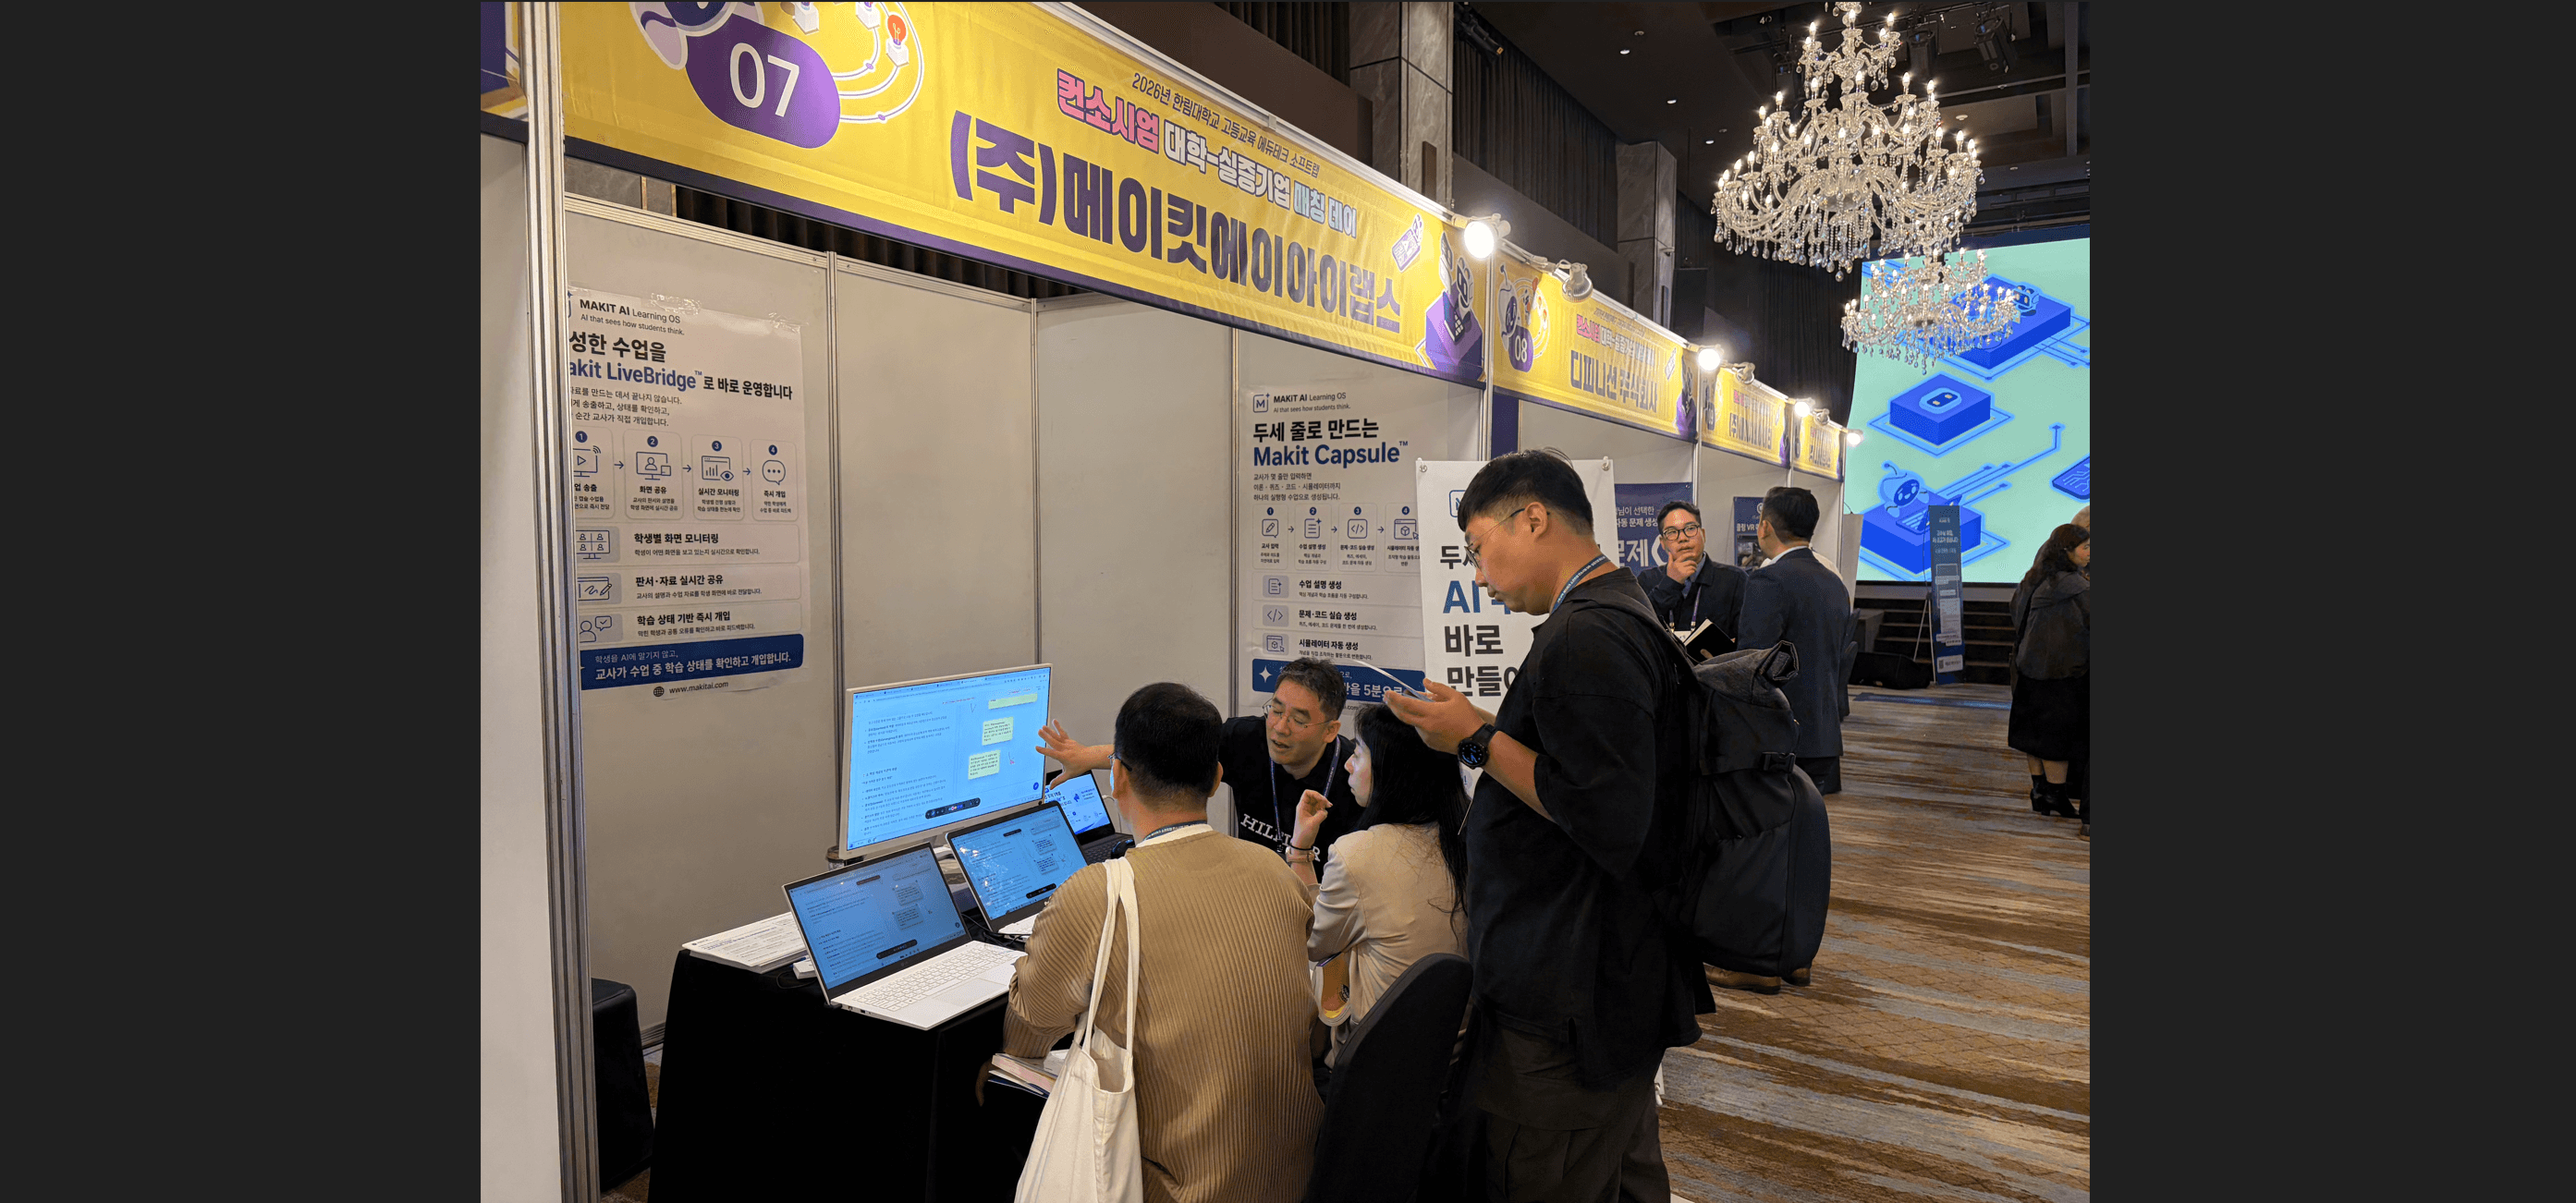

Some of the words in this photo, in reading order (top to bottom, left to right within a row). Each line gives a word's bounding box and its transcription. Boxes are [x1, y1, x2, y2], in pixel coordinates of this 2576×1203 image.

[730, 42, 800, 118] 07
[1132, 72, 1171, 105] 2026년
[1172, 92, 1220, 129] 한림대학교
[1221, 117, 1256, 148] 고등교육
[1257, 136, 1289, 163] 에듀테크
[1289, 153, 1320, 178] 소프트랩
[1057, 67, 1159, 154] 컨소시엄
[1164, 118, 1291, 211] 대학-실증기업
[1293, 180, 1325, 225] 매칭
[1328, 196, 1357, 239] 데이
[950, 109, 1400, 334] (주)메이킷에이아이랩스
[580, 299, 617, 313] MAKIT
[618, 305, 630, 316] AI
[632, 309, 667, 323] Learning
[668, 314, 681, 323] OS
[590, 315, 604, 324] that
[622, 320, 637, 328] how
[639, 322, 666, 333] students
[667, 327, 685, 335] think.
[612, 336, 666, 363] 수업을
[1515, 334, 1528, 363] 08
[591, 388, 614, 398] 만드는
[615, 391, 629, 400] 데서
[631, 392, 653, 402] 끝나지
[653, 394, 682, 405] 않습니다.
[717, 377, 740, 394] 바로
[742, 380, 793, 401] 운영합니다
[1299, 394, 1308, 402] AI
[1309, 393, 1336, 402] Learning
[1337, 392, 1347, 400] OS
[582, 399, 615, 411] 송출하고,
[617, 403, 638, 413] 상태를
[640, 405, 670, 416] 확인하고,
[575, 412, 591, 421] 순간
[592, 412, 616, 423] 교사가
[617, 414, 631, 424] 직접
[633, 416, 669, 427] 개입합니다.
[1253, 421, 1285, 443] 두세
[1290, 420, 1323, 442] 줄로
[1328, 418, 1379, 440] 만드는
[1253, 444, 1309, 467] Makit
[639, 485, 653, 493] 화면
[698, 488, 716, 496] 실시간
[717, 488, 739, 497] 모니터링
[1616, 506, 1632, 516] 님이
[1633, 505, 1654, 516] 선택한
[1630, 517, 1643, 528] 문제
[634, 533, 662, 544] 학생별
[664, 533, 682, 544] 화면
[685, 533, 719, 544] 모니터링
[635, 577, 678, 588] 판서·자료
[679, 575, 705, 587] 실시간
[707, 575, 723, 585] 공유
[1299, 579, 1312, 589] 수업
[1313, 580, 1326, 589] 설명
[1328, 580, 1342, 590] 생성
[637, 615, 655, 626] 학습
[657, 614, 675, 625] 상태
[678, 613, 694, 624] 기반
[696, 612, 713, 622] 즉시
[714, 611, 730, 621] 개입
[1329, 611, 1342, 620] 실습
[1344, 612, 1357, 621] 생성
[1299, 638, 1330, 649] 시뮬레이터
[1331, 640, 1344, 650] 자동
[1345, 641, 1359, 650] 생성
[1444, 625, 1504, 657] 바로
[595, 666, 627, 680] 교사가
[629, 664, 650, 678] 수업
[652, 663, 663, 675] 중
[665, 662, 685, 674] 학습
[687, 658, 714, 673] 상태를
[715, 656, 749, 669] 확인하고
[751, 651, 791, 665] 개입합니다.
[669, 681, 729, 694] www.makitai.com
[1240, 813, 1321, 862] HILIR
